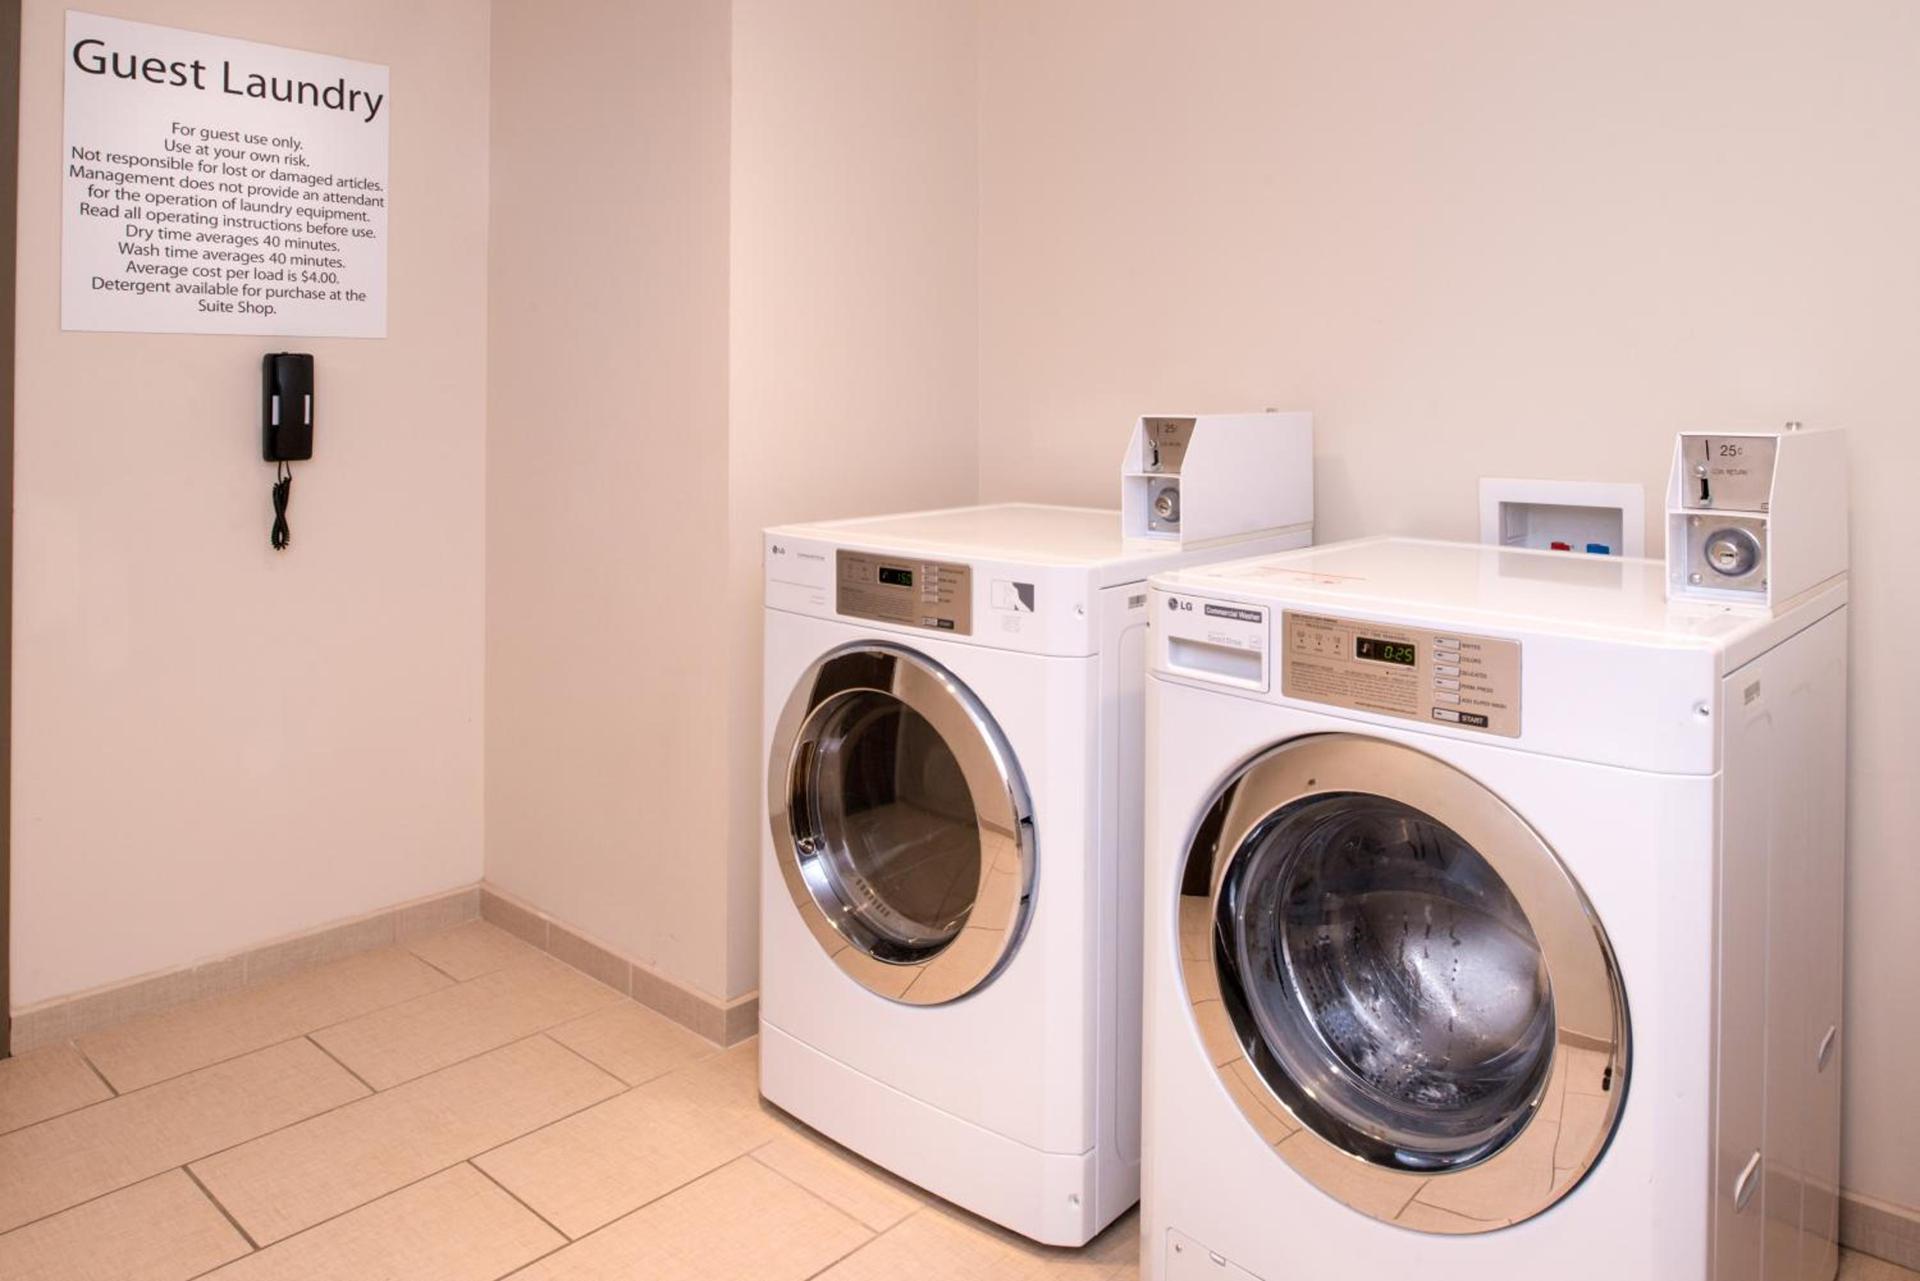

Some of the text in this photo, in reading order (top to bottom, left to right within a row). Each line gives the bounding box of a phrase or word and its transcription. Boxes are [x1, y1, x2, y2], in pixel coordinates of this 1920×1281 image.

[73, 39, 384, 123] Guest Laundry
[171, 122, 303, 151] For guest use only.
[164, 139, 309, 167] Use at your own risk.
[72, 146, 383, 191] Not responsible for lost or damaged articles.
[69, 165, 384, 208] Management does not provide an attendant
[88, 184, 370, 222] for the operation of laundry equipment.
[80, 203, 376, 238] Read all operating instructions before use.
[126, 224, 340, 252] Dry time averages 40 minutes.
[119, 242, 345, 268] Wash time averages 40 minutes.
[126, 261, 339, 285] Average cost per load is $4.00.
[92, 277, 366, 301] Detergent available for purchase at the
[198, 300, 276, 316] Suite Shop.
